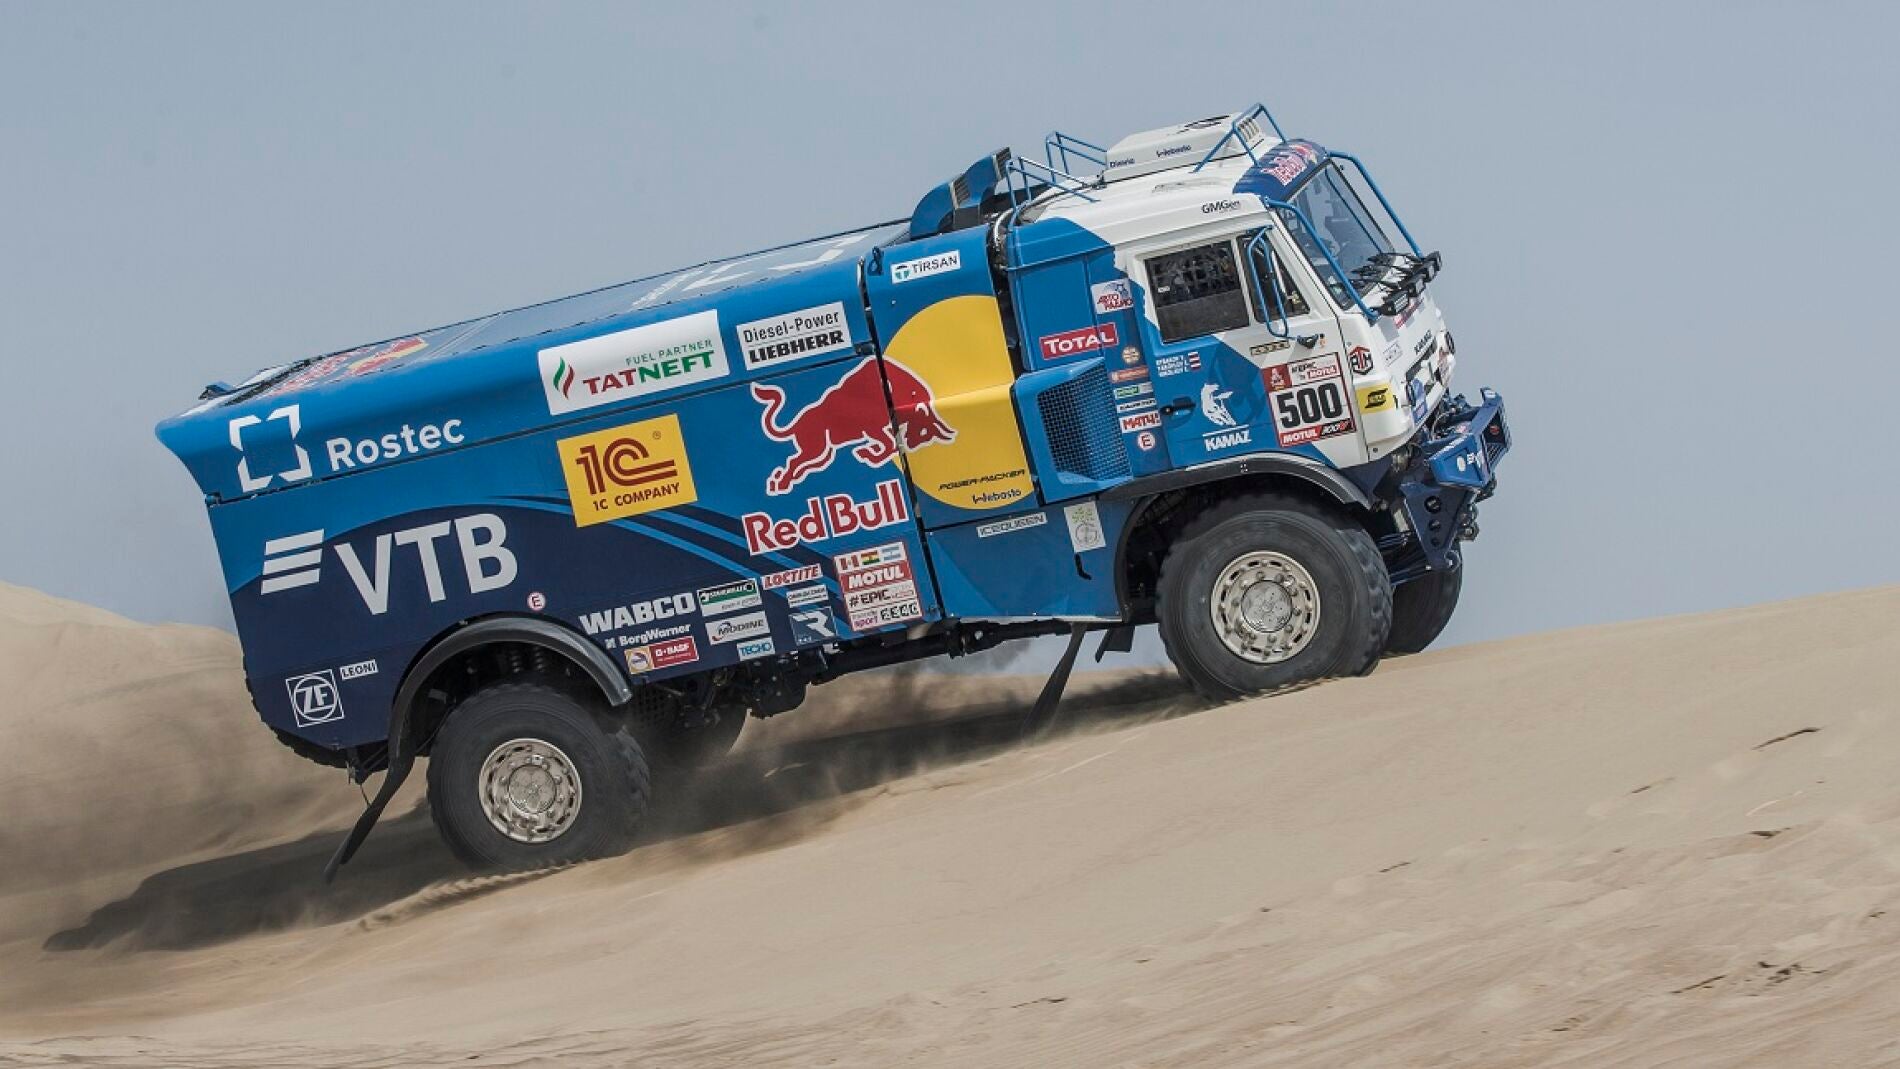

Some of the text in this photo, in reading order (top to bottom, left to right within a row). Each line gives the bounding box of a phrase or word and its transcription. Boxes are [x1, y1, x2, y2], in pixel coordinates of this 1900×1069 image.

[743, 310, 840, 344] Diesel-Power
[626, 339, 713, 366] FUEL PARTNER
[748, 330, 845, 363] LIEBHERR
[1044, 327, 1115, 355] TOTAL
[582, 349, 715, 396] TATNEFT
[1276, 383, 1343, 428] 500
[326, 418, 464, 472] Rostec
[1141, 436, 1152, 447] E
[1204, 429, 1252, 452] KAMAZ
[1283, 428, 1318, 444] MOTUL
[938, 468, 1025, 492] POWER-PACKER
[614, 482, 681, 507] COMPANY
[742, 478, 908, 555] Red Bull
[333, 513, 519, 616] VTB
[764, 566, 820, 589] LOCTITE
[848, 566, 904, 589] MOTUL
[531, 596, 541, 608] E
[578, 592, 697, 636] WABCO
[619, 624, 692, 647] BorgWarner
[718, 618, 765, 636] MODINE
[341, 661, 376, 677] LEONI
[296, 683, 335, 713] ZF
